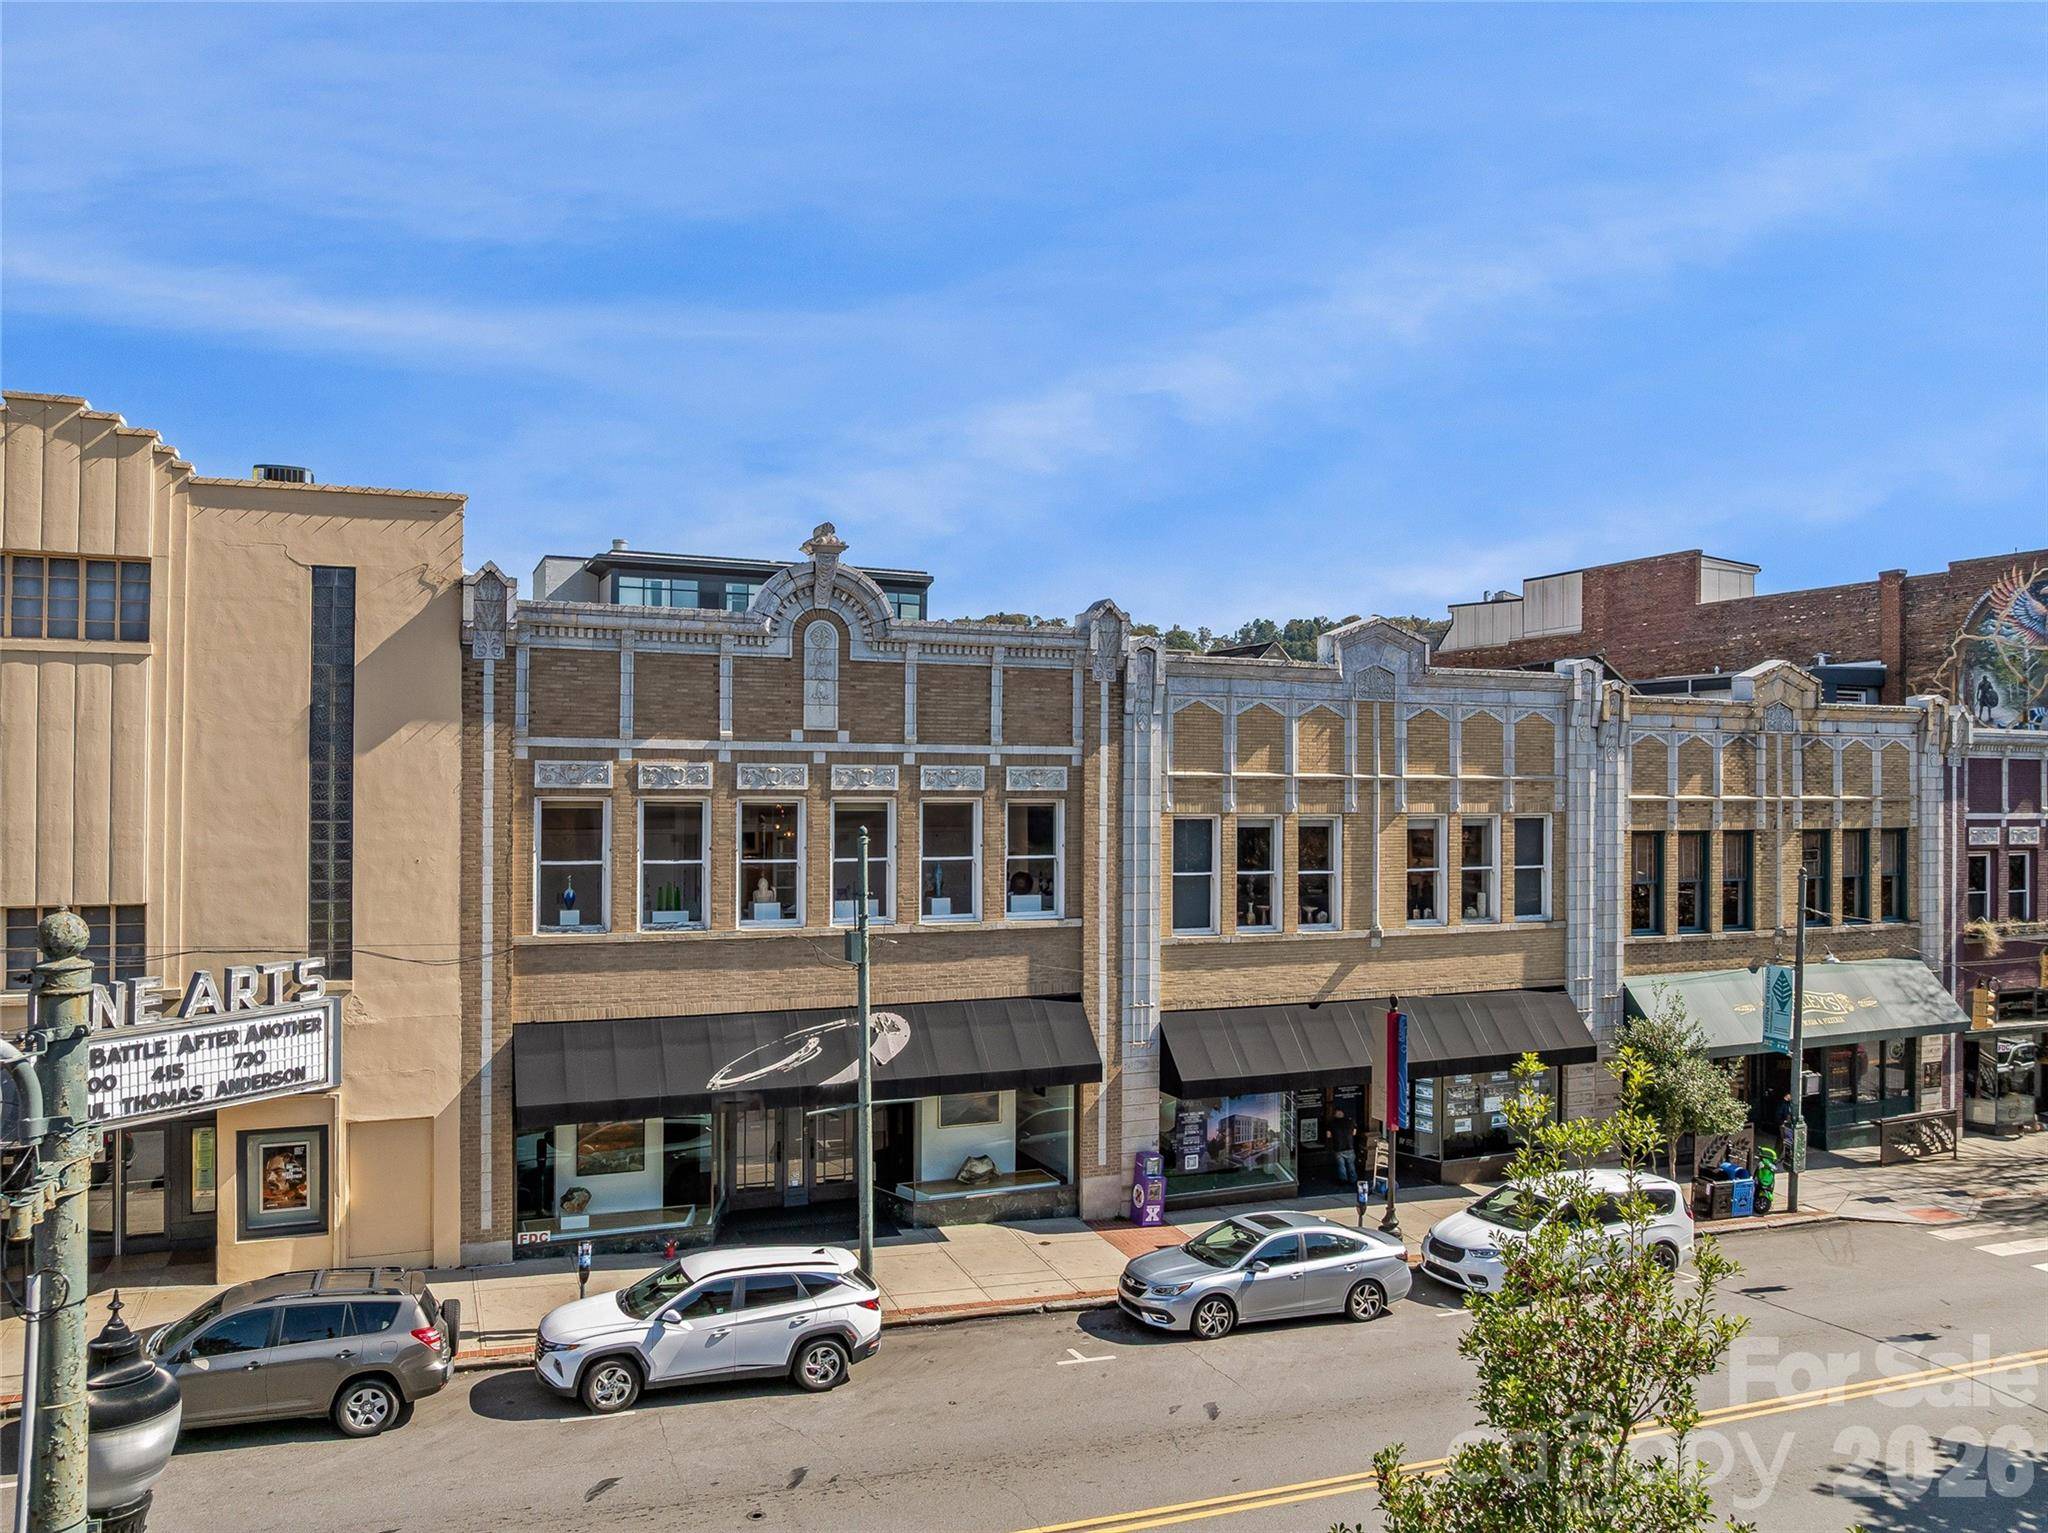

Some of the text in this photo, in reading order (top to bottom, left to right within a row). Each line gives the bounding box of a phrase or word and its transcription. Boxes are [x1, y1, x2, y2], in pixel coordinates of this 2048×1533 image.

[177, 957, 327, 1018] ARTS
[90, 1017, 322, 1070] BATTLE AFTER ANOTHER
[151, 1062, 185, 1084] 415
[233, 1049, 267, 1071] 730
[88, 1065, 306, 1120] UL THOMAS ANDERSON
[520, 1232, 549, 1245] FDC
